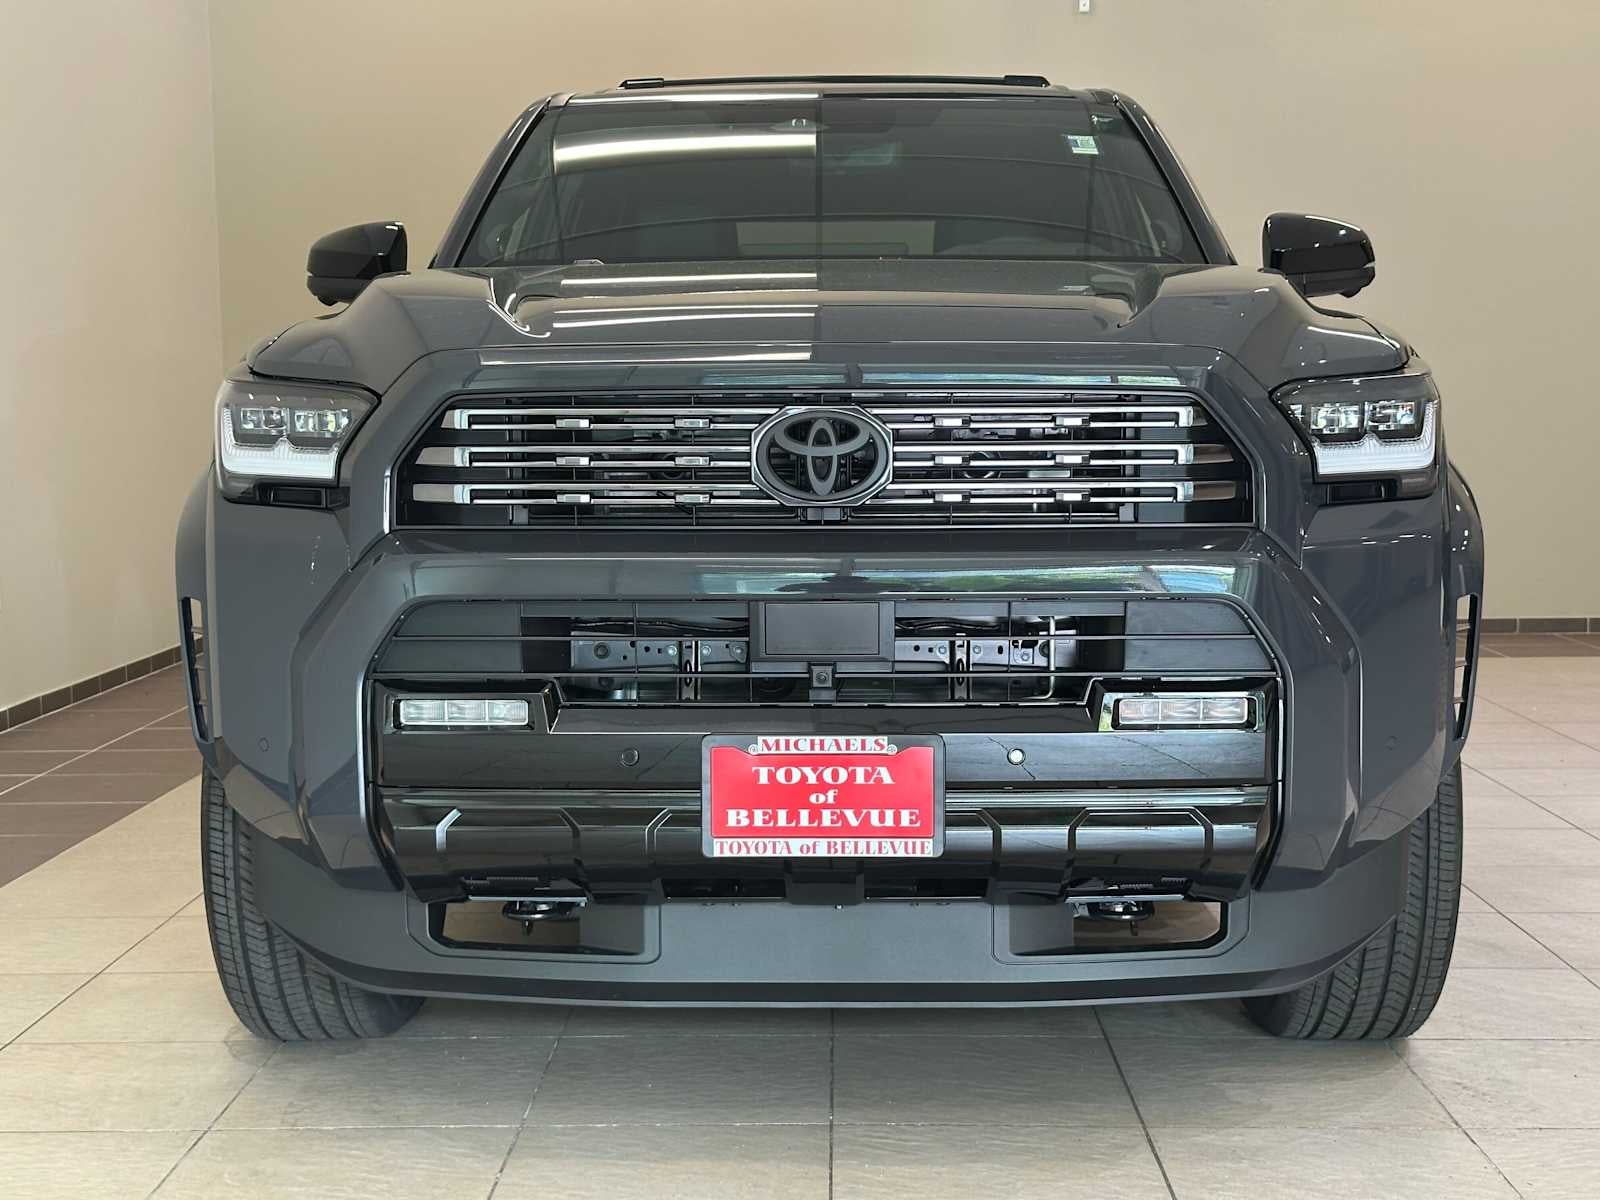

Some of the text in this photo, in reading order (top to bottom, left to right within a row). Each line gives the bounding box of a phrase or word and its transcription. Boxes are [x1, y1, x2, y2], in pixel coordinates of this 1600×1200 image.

[761, 738, 888, 752] MICHAELS
[752, 766, 895, 784] TOYOTA
[808, 789, 838, 804] of
[726, 808, 921, 827] BELLEVUE
[715, 840, 931, 855] TOYOTA of BELLEVUE
